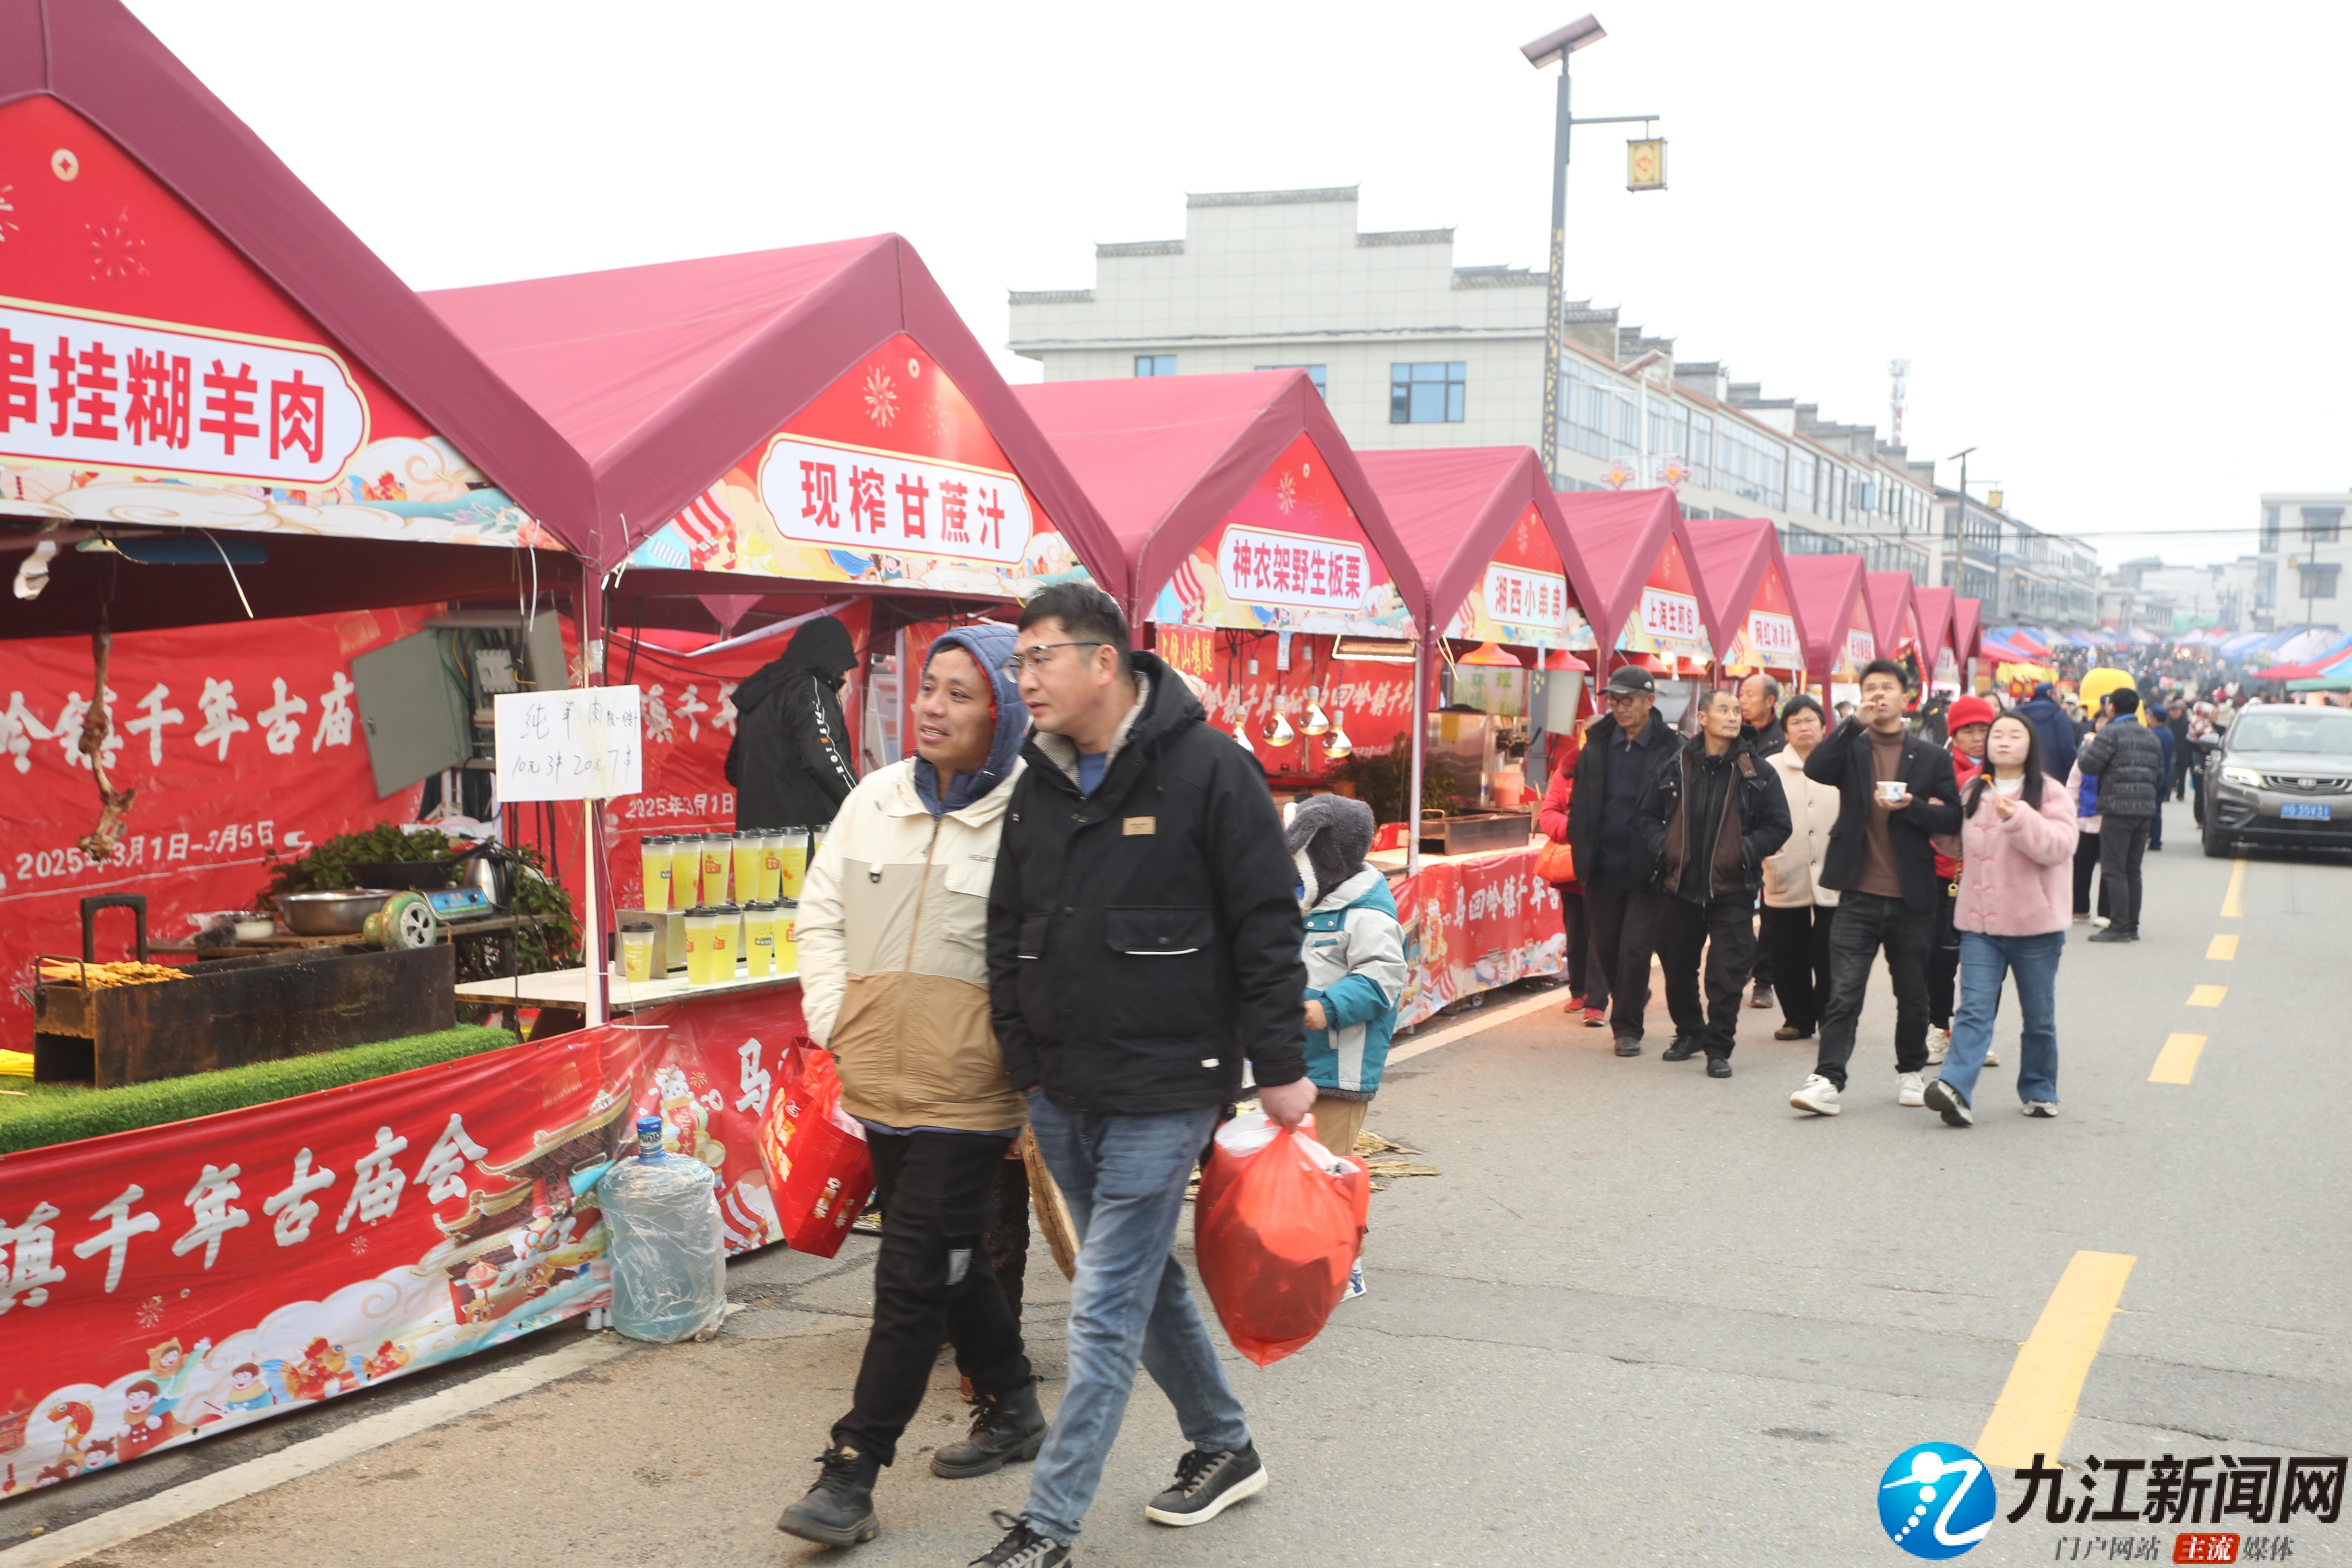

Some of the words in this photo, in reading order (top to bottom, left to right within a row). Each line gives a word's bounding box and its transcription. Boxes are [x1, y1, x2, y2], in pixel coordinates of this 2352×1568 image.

[799, 459, 1005, 549] 现榨甘蔗汁
[1233, 539, 1361, 599] 神农架野生板栗
[1495, 574, 1561, 621] 湘西小串串
[1648, 597, 1693, 635] 上海生煎包
